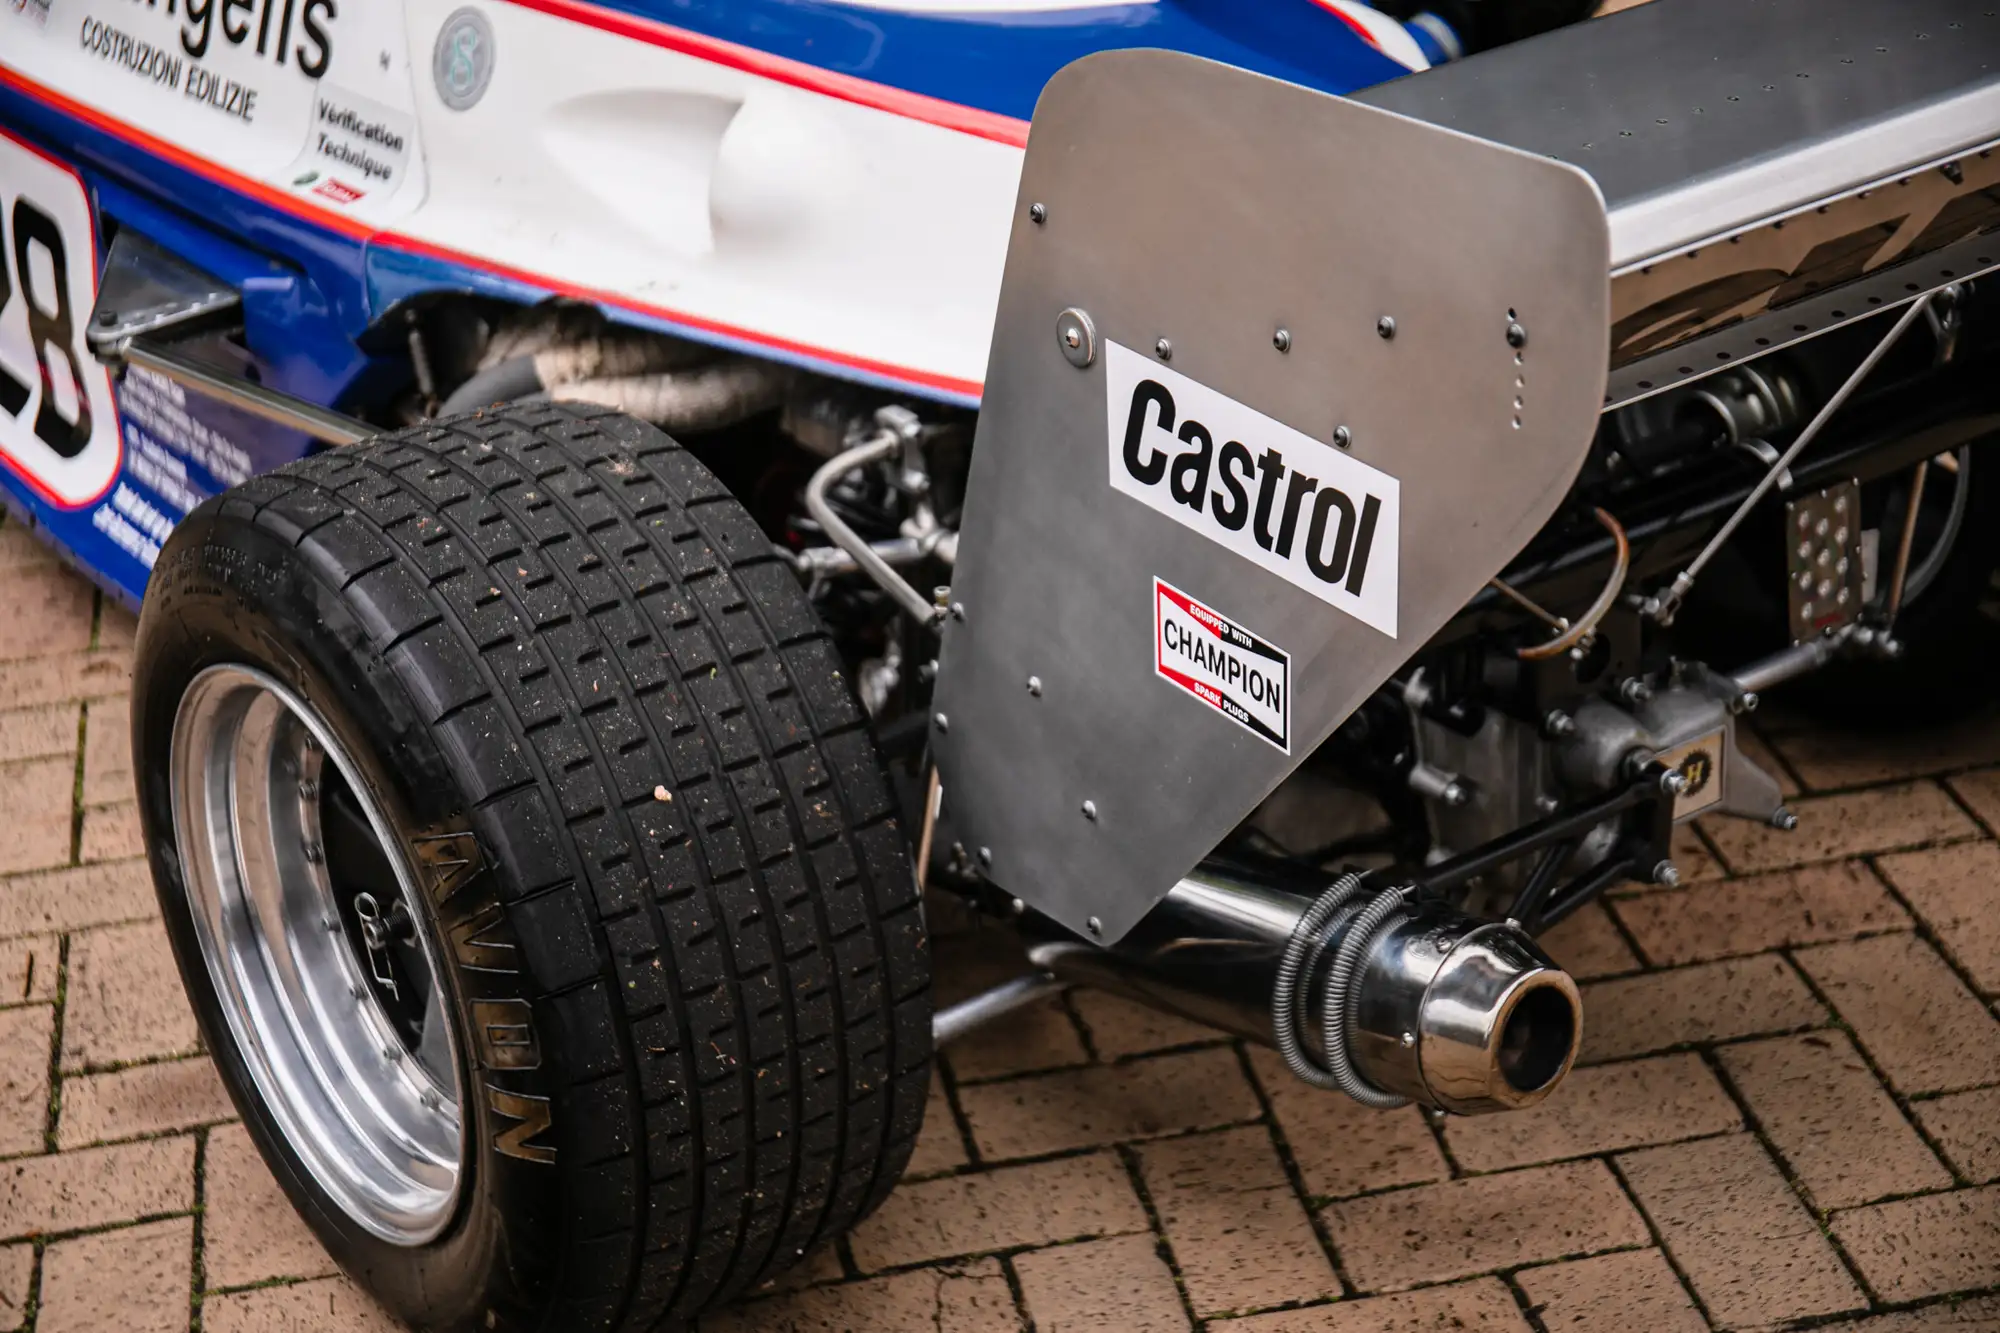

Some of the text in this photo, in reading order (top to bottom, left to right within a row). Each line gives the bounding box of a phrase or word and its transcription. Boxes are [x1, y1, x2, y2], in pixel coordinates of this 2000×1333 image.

[80, 16, 258, 122] COSTRUZIONI EDILIZIE
[317, 131, 393, 181] Technique
[1122, 379, 1382, 598] Castrol
[1164, 618, 1281, 714] CHAMPION
[1190, 603, 1253, 648] EQUIPPED WITH
[1194, 682, 1250, 723] SPARK PLUGS
[411, 831, 559, 1165] AVON
